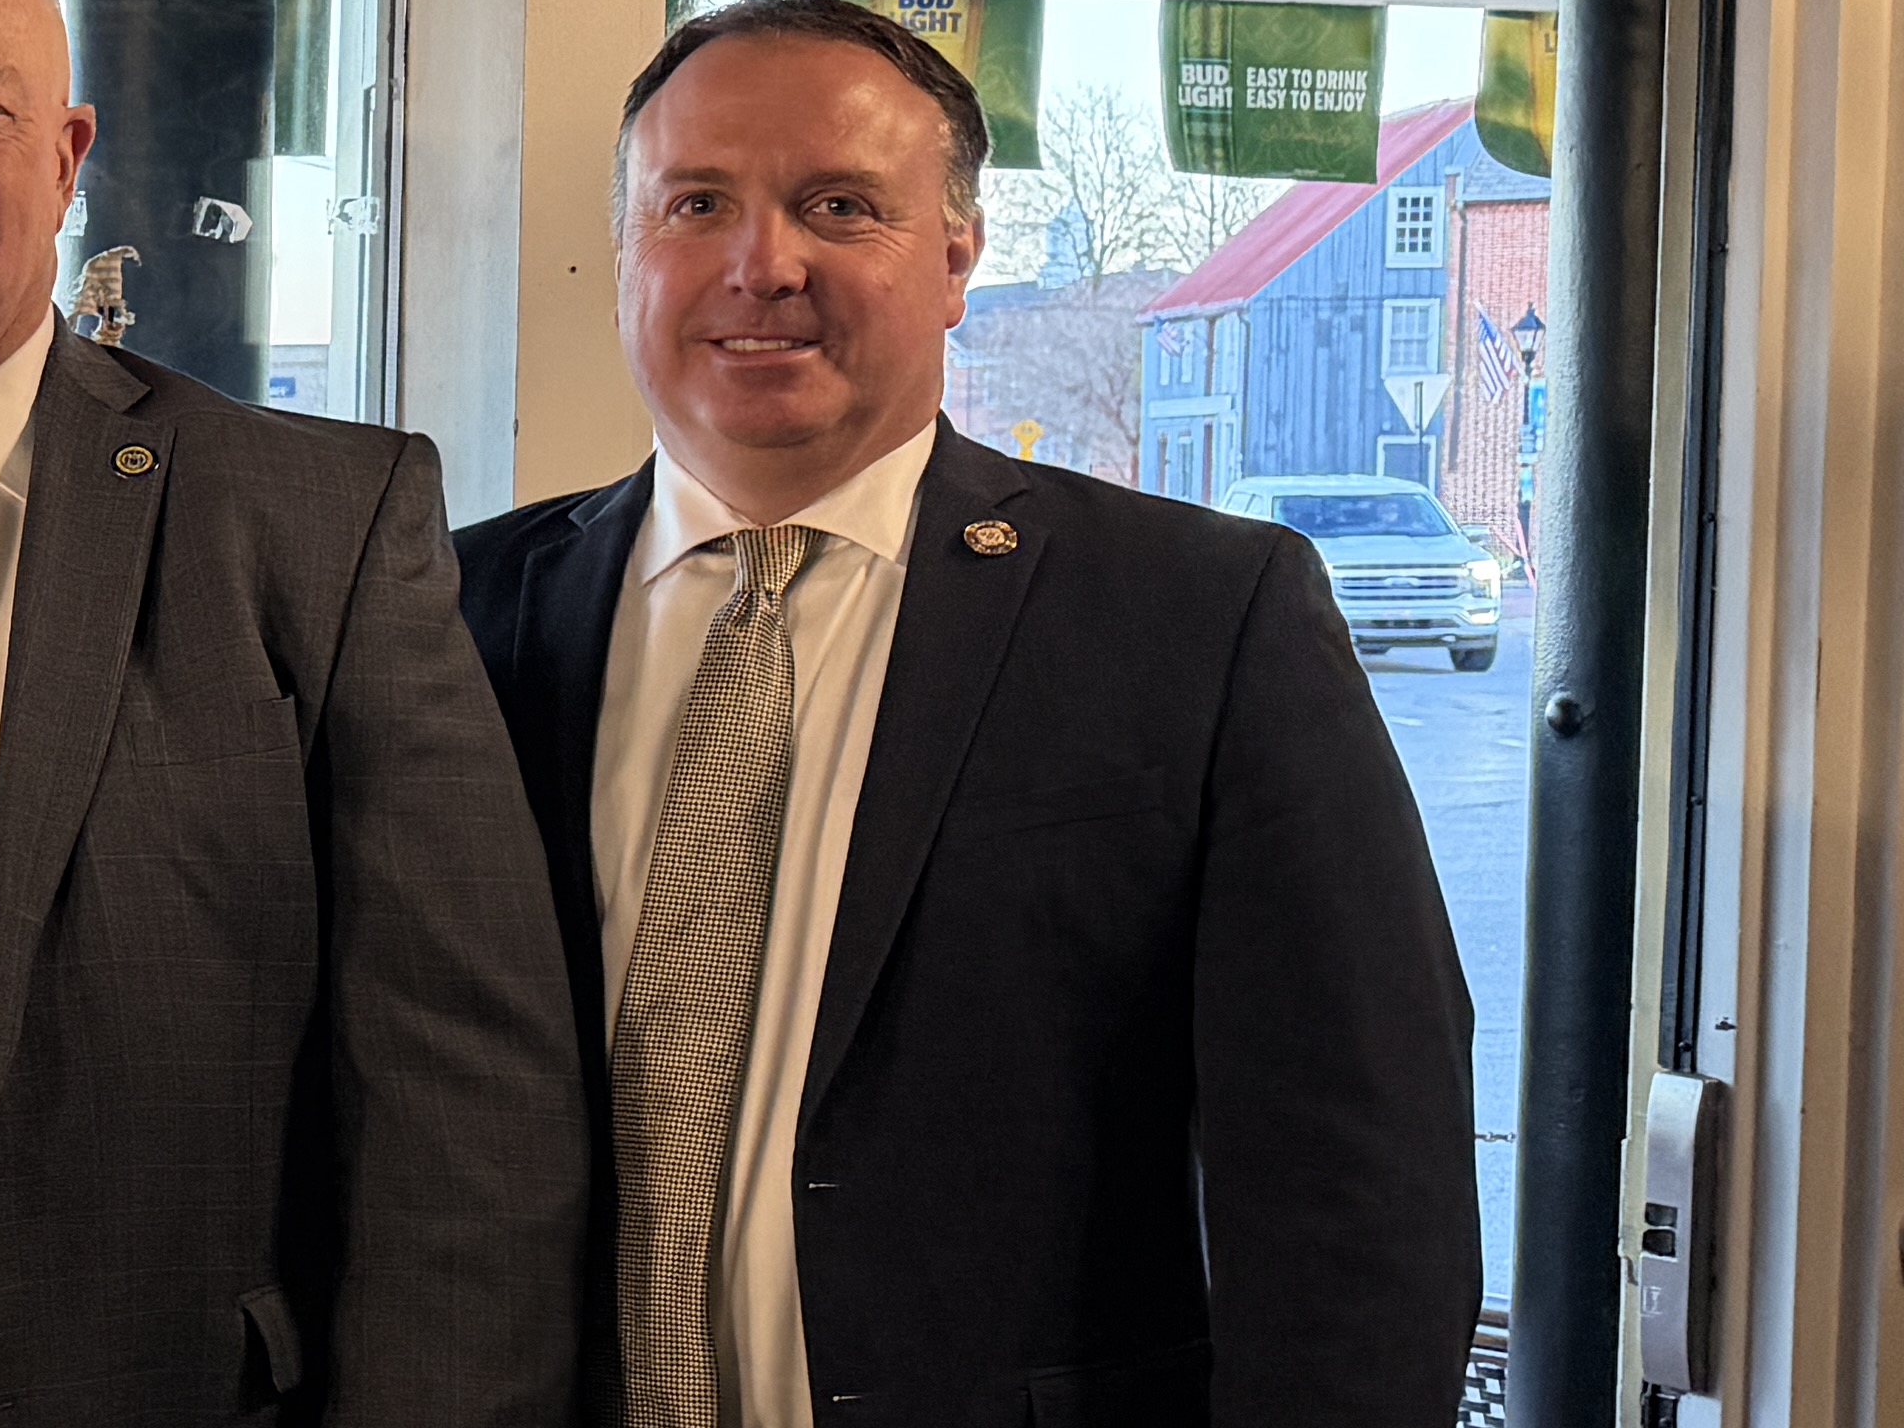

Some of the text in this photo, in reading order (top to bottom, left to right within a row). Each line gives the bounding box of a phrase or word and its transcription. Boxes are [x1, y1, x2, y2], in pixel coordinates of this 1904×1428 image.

[889, 11, 962, 33] IGHT
[1181, 64, 1230, 86] BUD
[1246, 66, 1368, 92] EASY TO DRINK
[1178, 85, 1233, 108] LIGHT
[1246, 87, 1366, 112] EASY TO ENJOY
